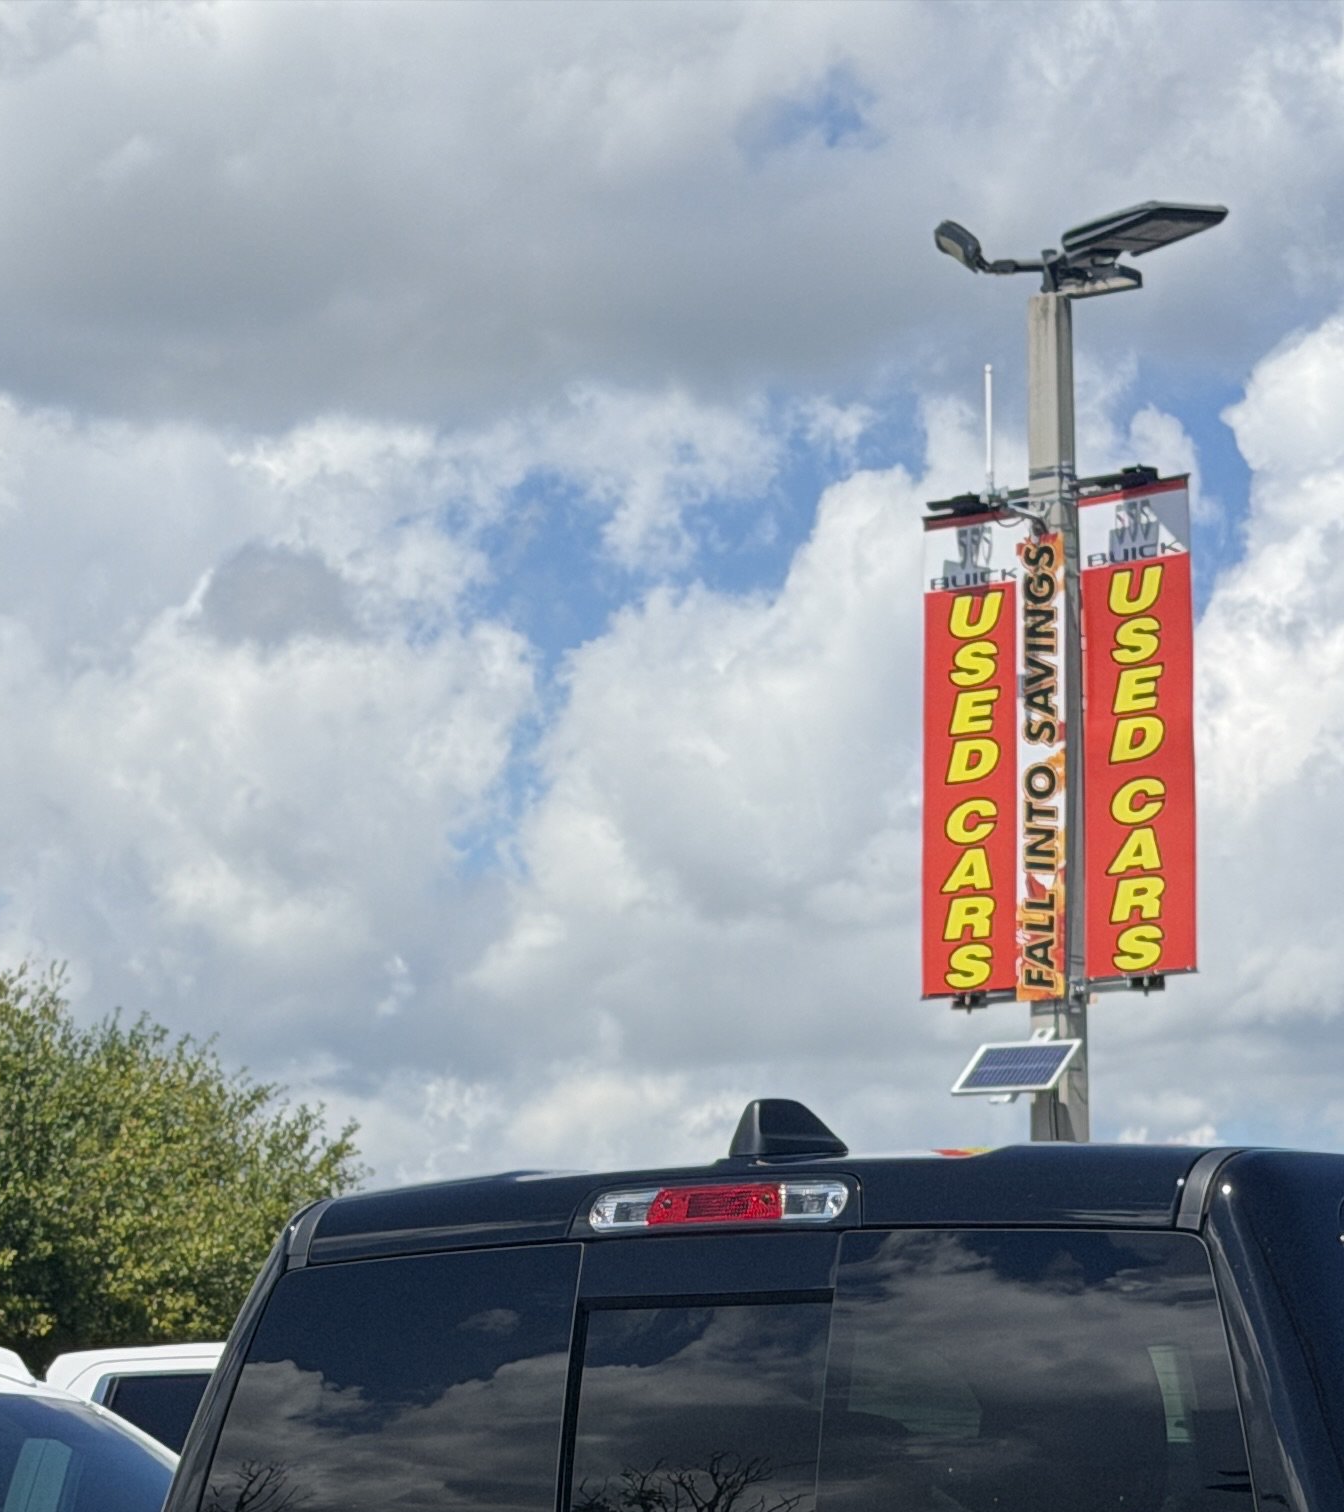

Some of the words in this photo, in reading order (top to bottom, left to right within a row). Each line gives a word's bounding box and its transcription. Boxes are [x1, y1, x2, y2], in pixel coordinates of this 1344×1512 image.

[930, 567, 1017, 590] BUICK
[1022, 543, 1057, 746] SAVINGS
[1087, 541, 1182, 567] BUICK
[944, 590, 1004, 785] USED
[1108, 563, 1166, 765] USED
[940, 797, 998, 989] CARS
[1022, 762, 1057, 873] INTO
[1105, 776, 1166, 972] CARS
[1022, 891, 1056, 989] FALL
